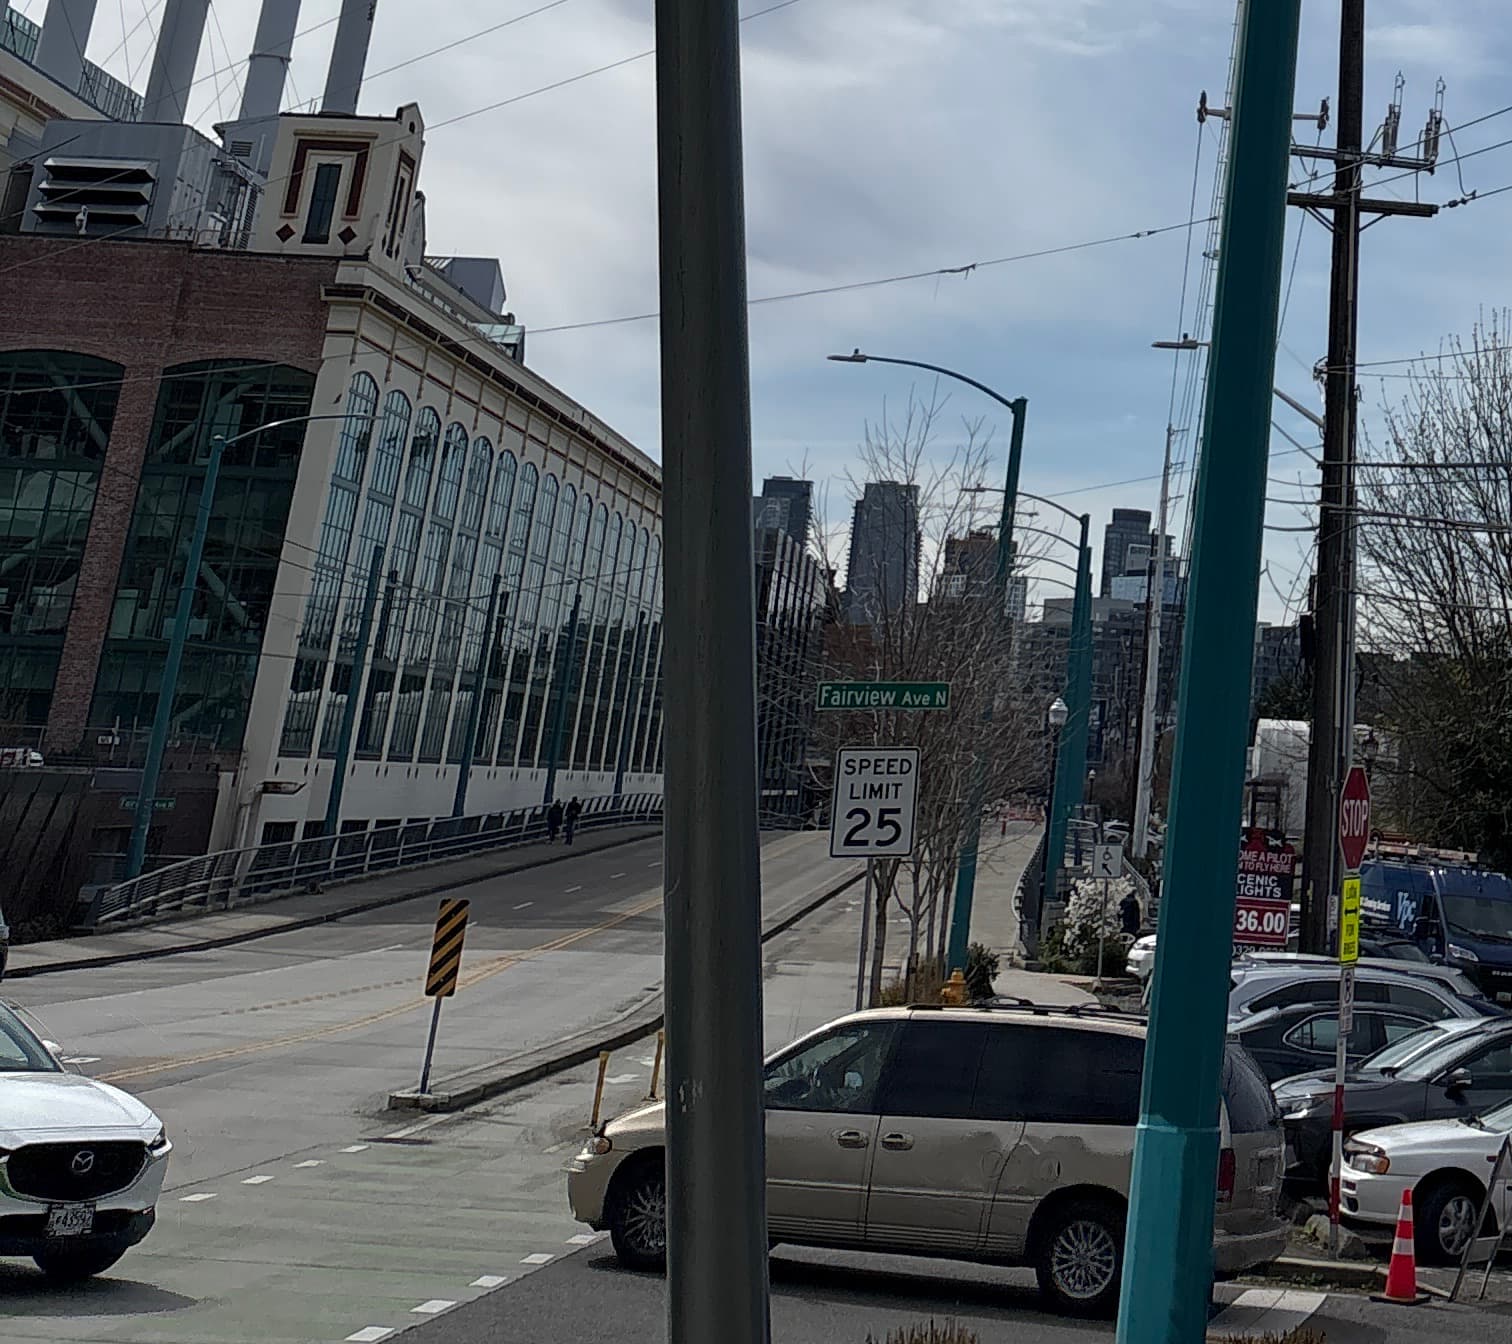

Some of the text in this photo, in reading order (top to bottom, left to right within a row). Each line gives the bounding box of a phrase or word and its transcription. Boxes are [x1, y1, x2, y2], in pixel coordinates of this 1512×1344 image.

[819, 685, 947, 707] Fairview Ave N
[843, 758, 913, 776] SPEED
[849, 783, 903, 800] LIMIT
[842, 807, 902, 848] 25
[1341, 799, 1369, 838] STOP
[1255, 862, 1269, 873] FLY
[1266, 852, 1293, 865] PILOT
[1236, 883, 1282, 899] IGHTS
[1235, 909, 1285, 934] 36.00
